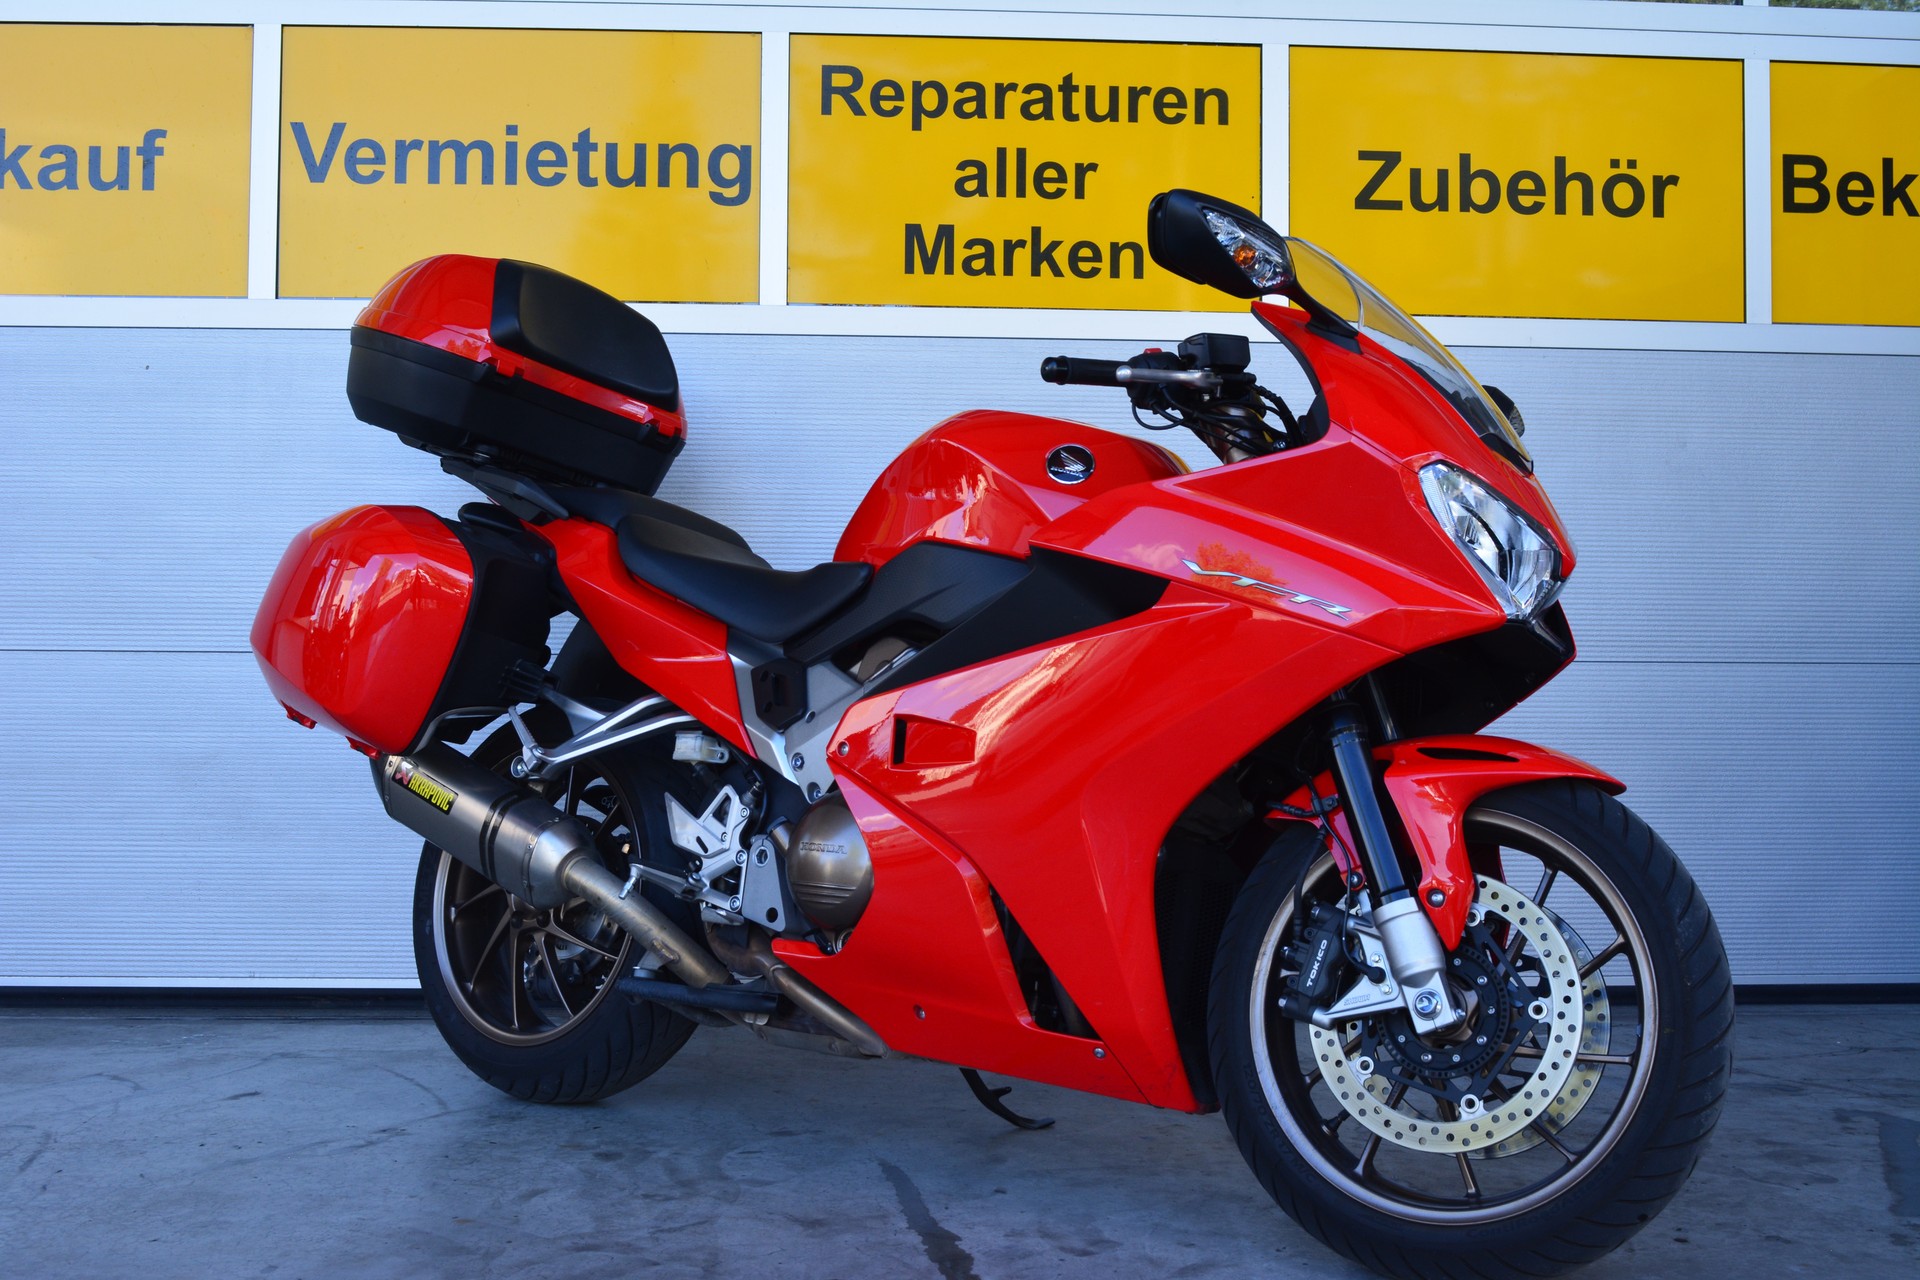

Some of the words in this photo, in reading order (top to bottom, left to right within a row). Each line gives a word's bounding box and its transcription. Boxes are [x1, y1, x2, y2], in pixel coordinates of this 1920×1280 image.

[820, 64, 1229, 131] Reparaturen
[0, 127, 168, 192] kauf
[289, 121, 753, 207] Vermietung
[954, 146, 1099, 200] aller
[1354, 149, 1681, 219] Zubehör
[1781, 153, 1920, 218] Bek
[904, 223, 1145, 280] Marken
[799, 840, 848, 855] HONDA
[1306, 939, 1328, 988] TOKICO
